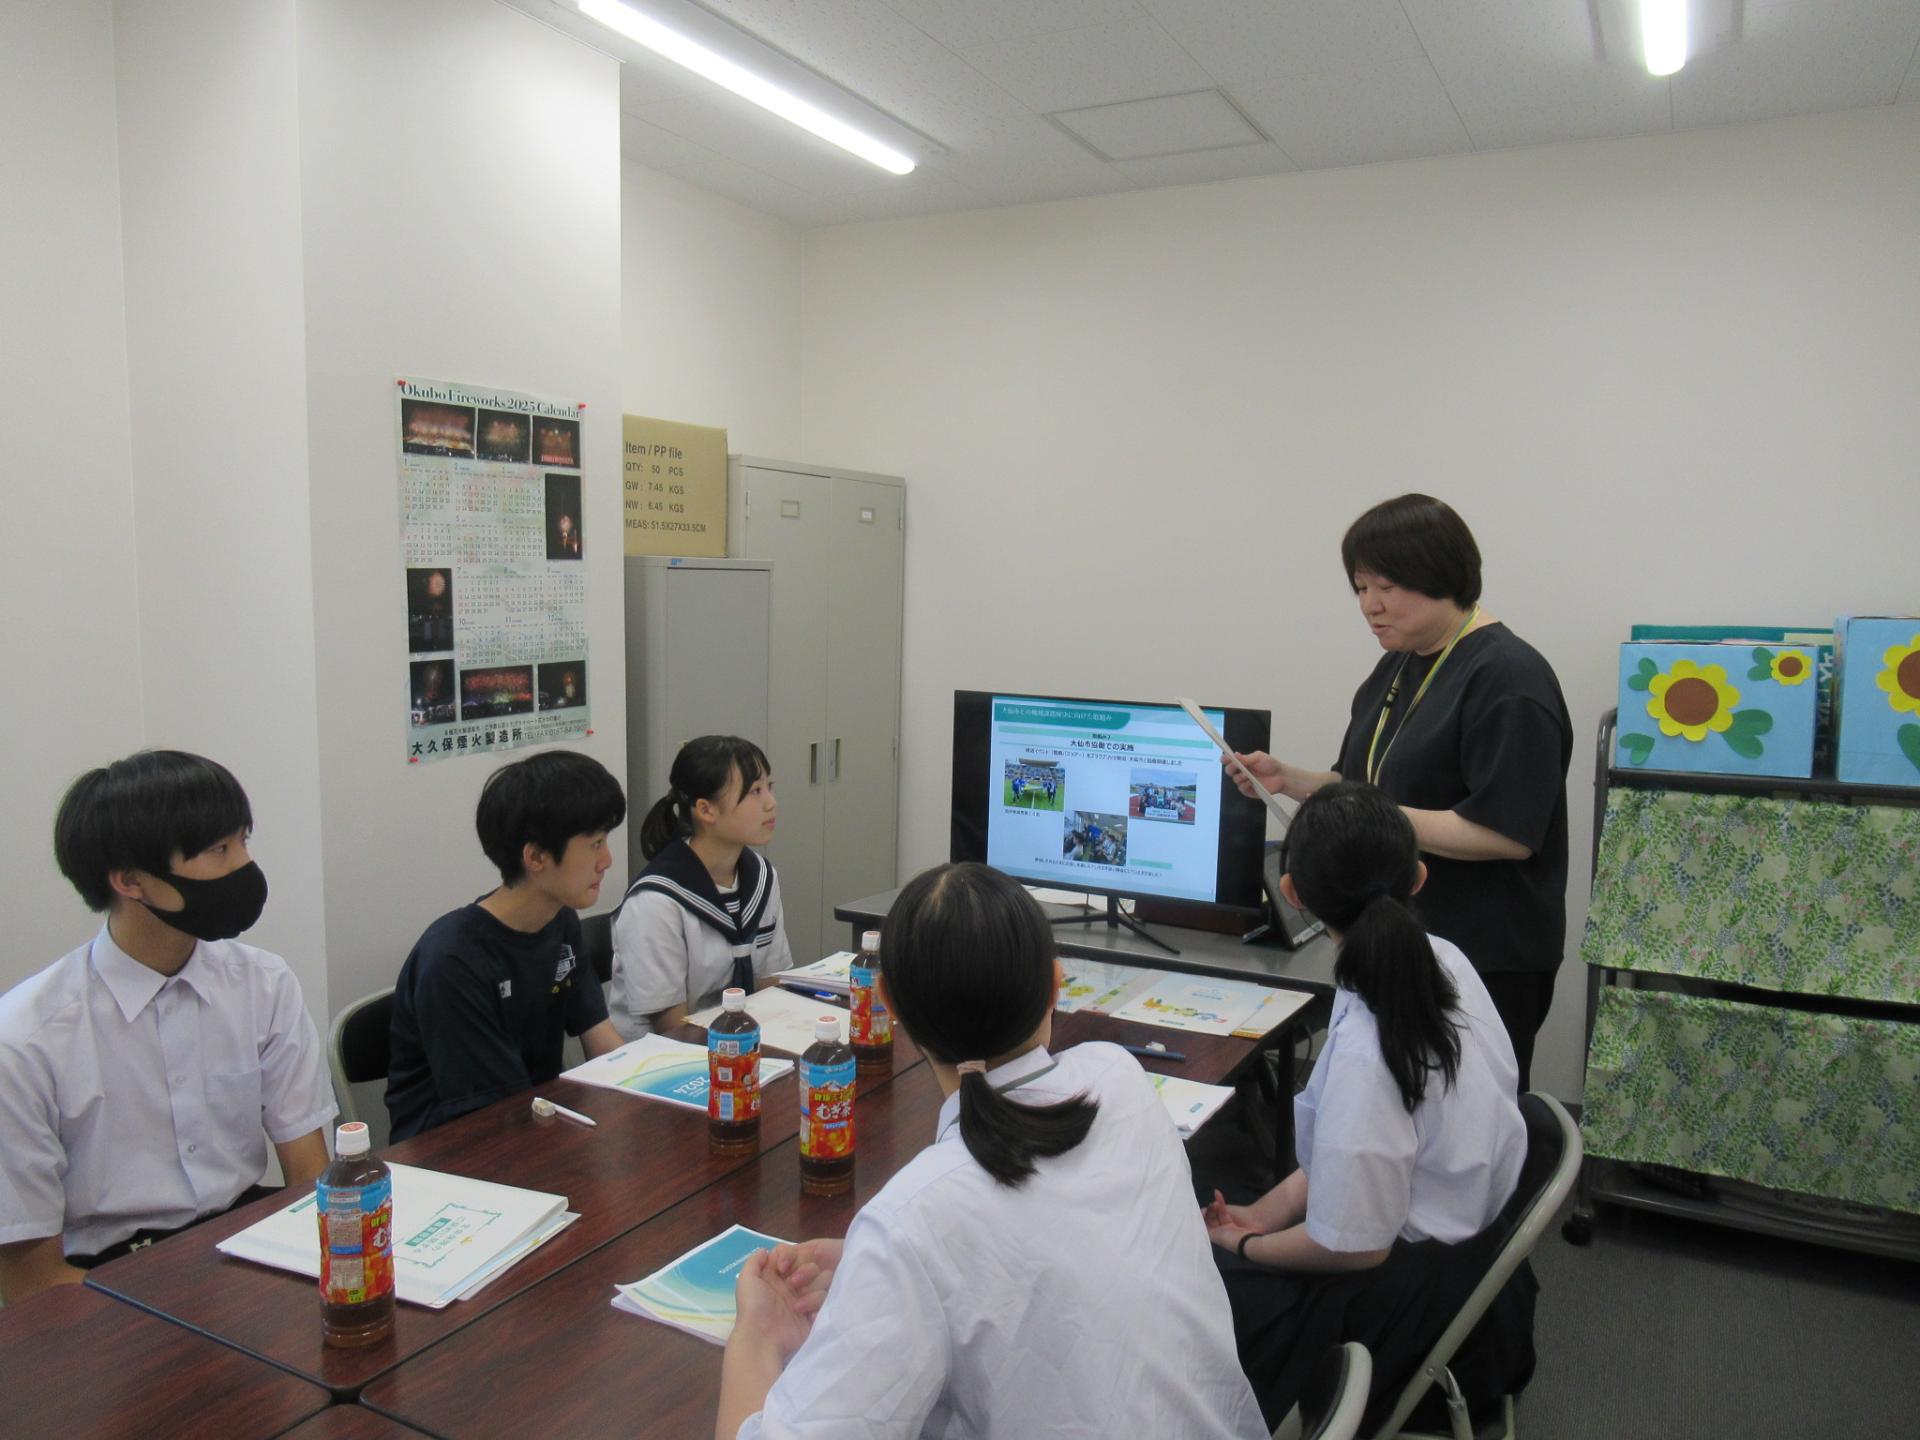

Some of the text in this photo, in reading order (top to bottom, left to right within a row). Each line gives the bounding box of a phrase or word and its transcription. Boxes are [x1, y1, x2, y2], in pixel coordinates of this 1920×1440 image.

[401, 383, 580, 419] Okubo Fireworks 2025 Calendar
[625, 441, 646, 455] Item
[654, 445, 667, 457] PP
[669, 447, 683, 460] file
[625, 461, 684, 477] QTY: 50 PCS
[669, 485, 685, 495] KGS
[669, 503, 685, 514] KGS
[625, 519, 650, 530] MEAS:
[816, 1102, 851, 1120] むぎ茶
